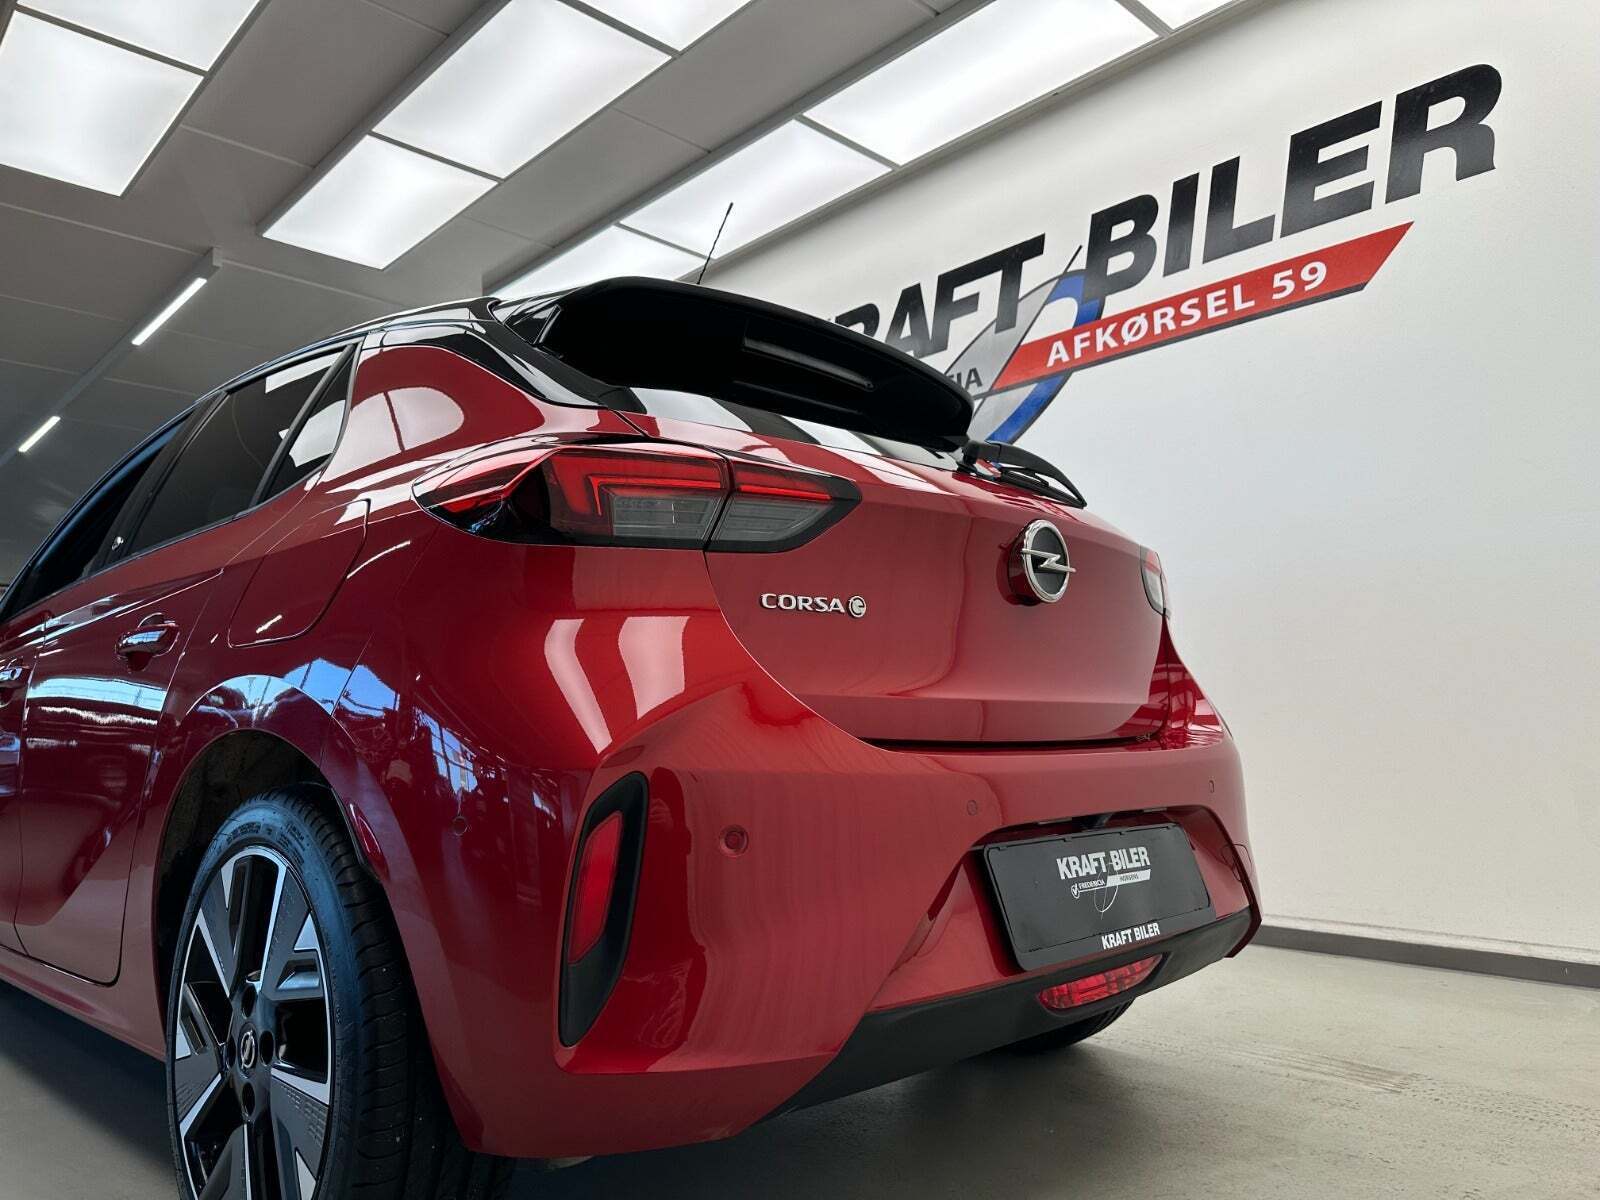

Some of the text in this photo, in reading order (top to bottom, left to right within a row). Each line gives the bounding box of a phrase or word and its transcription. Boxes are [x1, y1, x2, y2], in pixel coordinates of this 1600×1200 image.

[1082, 64, 1502, 303] BILER
[1047, 261, 1327, 367] AFKØRSEL 59
[761, 593, 845, 613] CORSA
[1057, 846, 1151, 880] KRAFT BILER
[1101, 922, 1160, 950] KRAFT BILER
